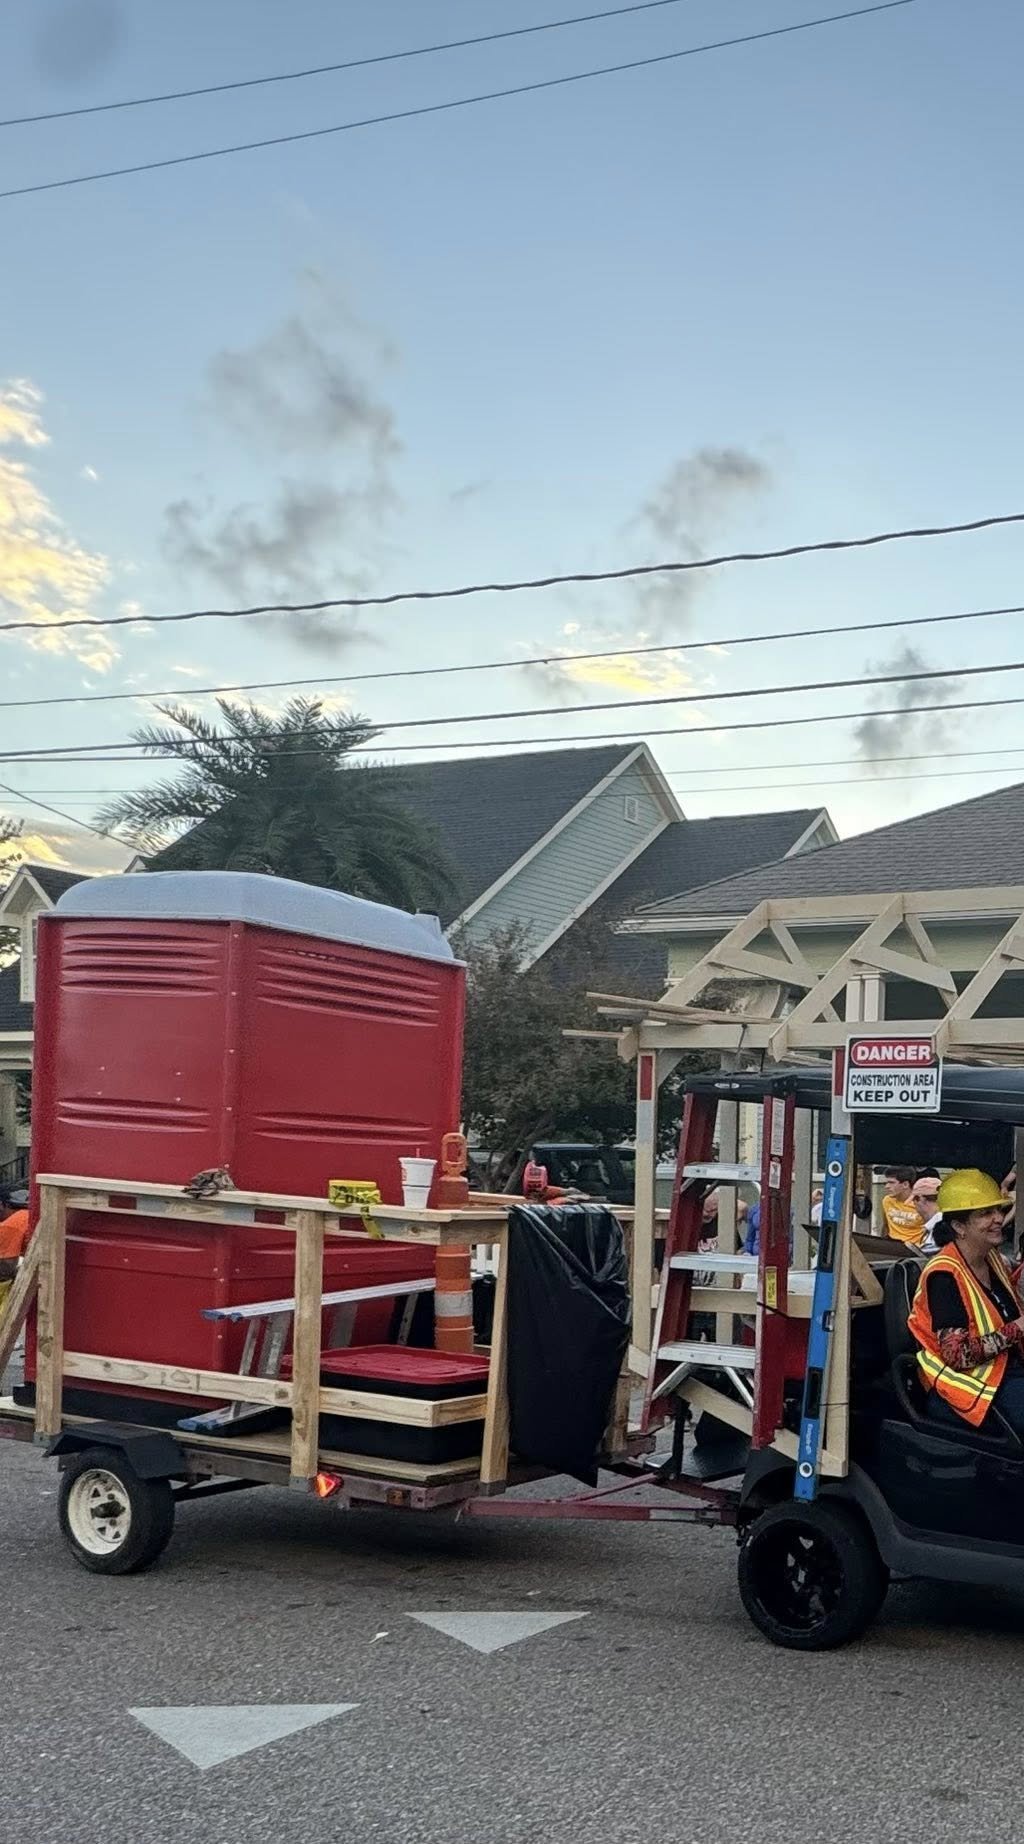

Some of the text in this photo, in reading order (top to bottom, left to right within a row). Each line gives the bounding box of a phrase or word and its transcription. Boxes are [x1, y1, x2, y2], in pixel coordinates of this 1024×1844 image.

[856, 1045, 931, 1061] DANGER
[850, 1074, 935, 1087] CONSTRUCTION AREA
[853, 1090, 931, 1103] KEEP OUT
